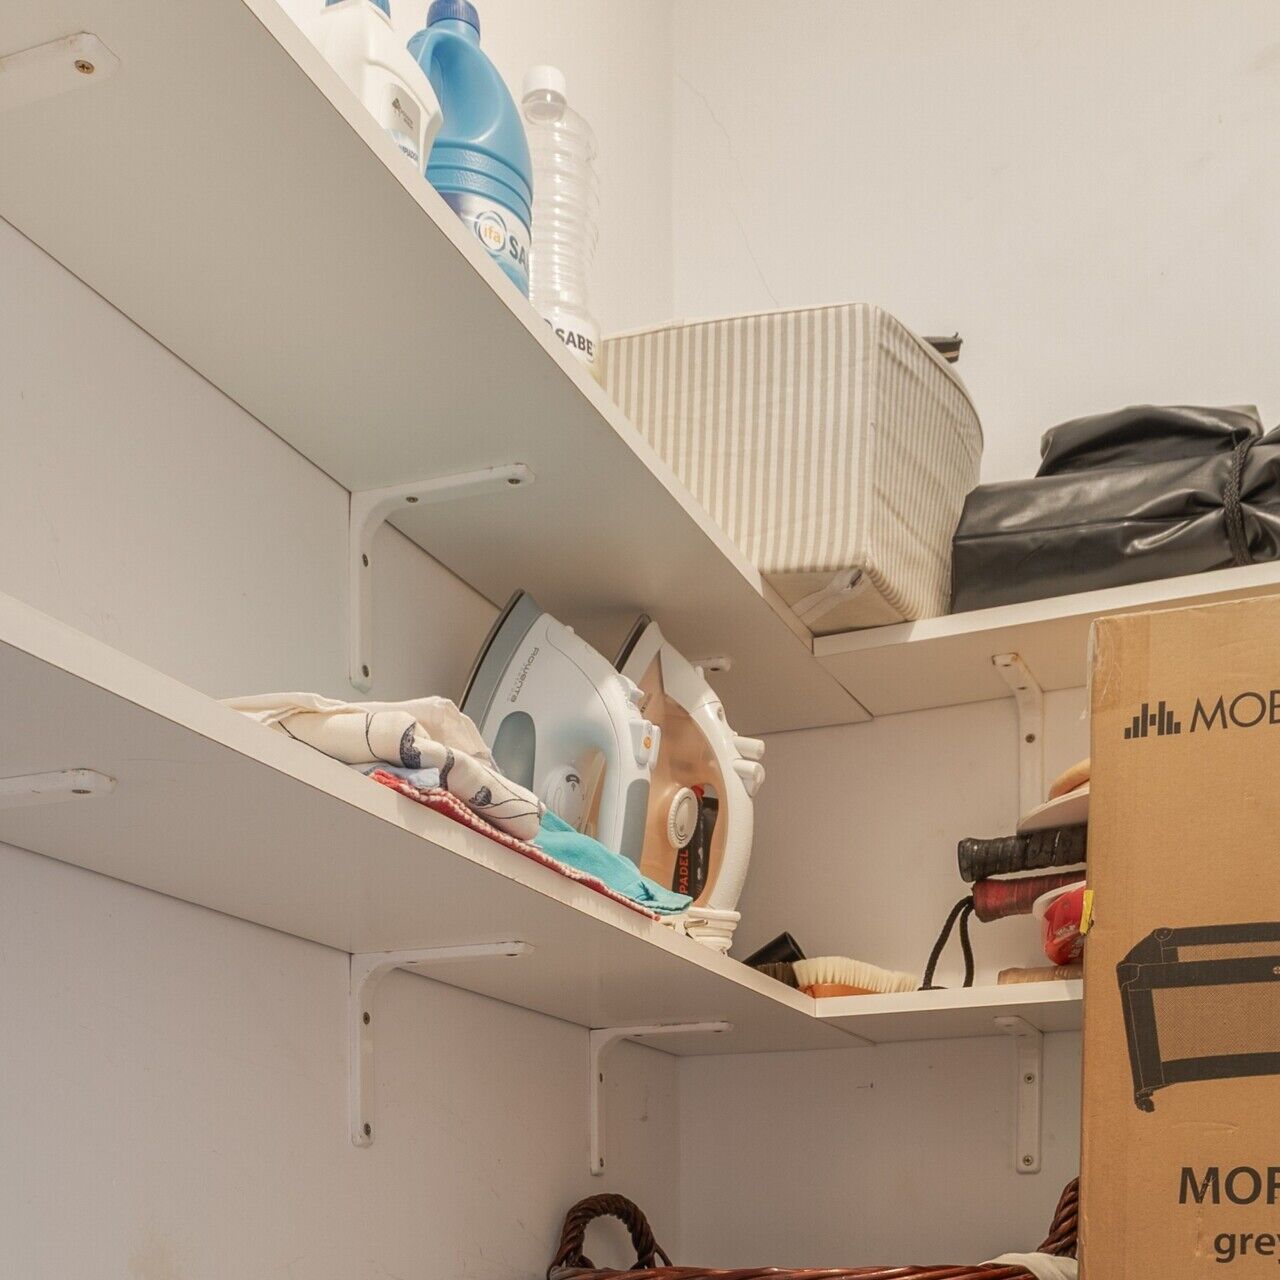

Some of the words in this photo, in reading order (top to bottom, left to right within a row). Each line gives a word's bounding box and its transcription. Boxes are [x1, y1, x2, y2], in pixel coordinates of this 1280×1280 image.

[509, 235, 529, 272] SA
[555, 328, 596, 356] SABE
[679, 850, 689, 894] PADEL
